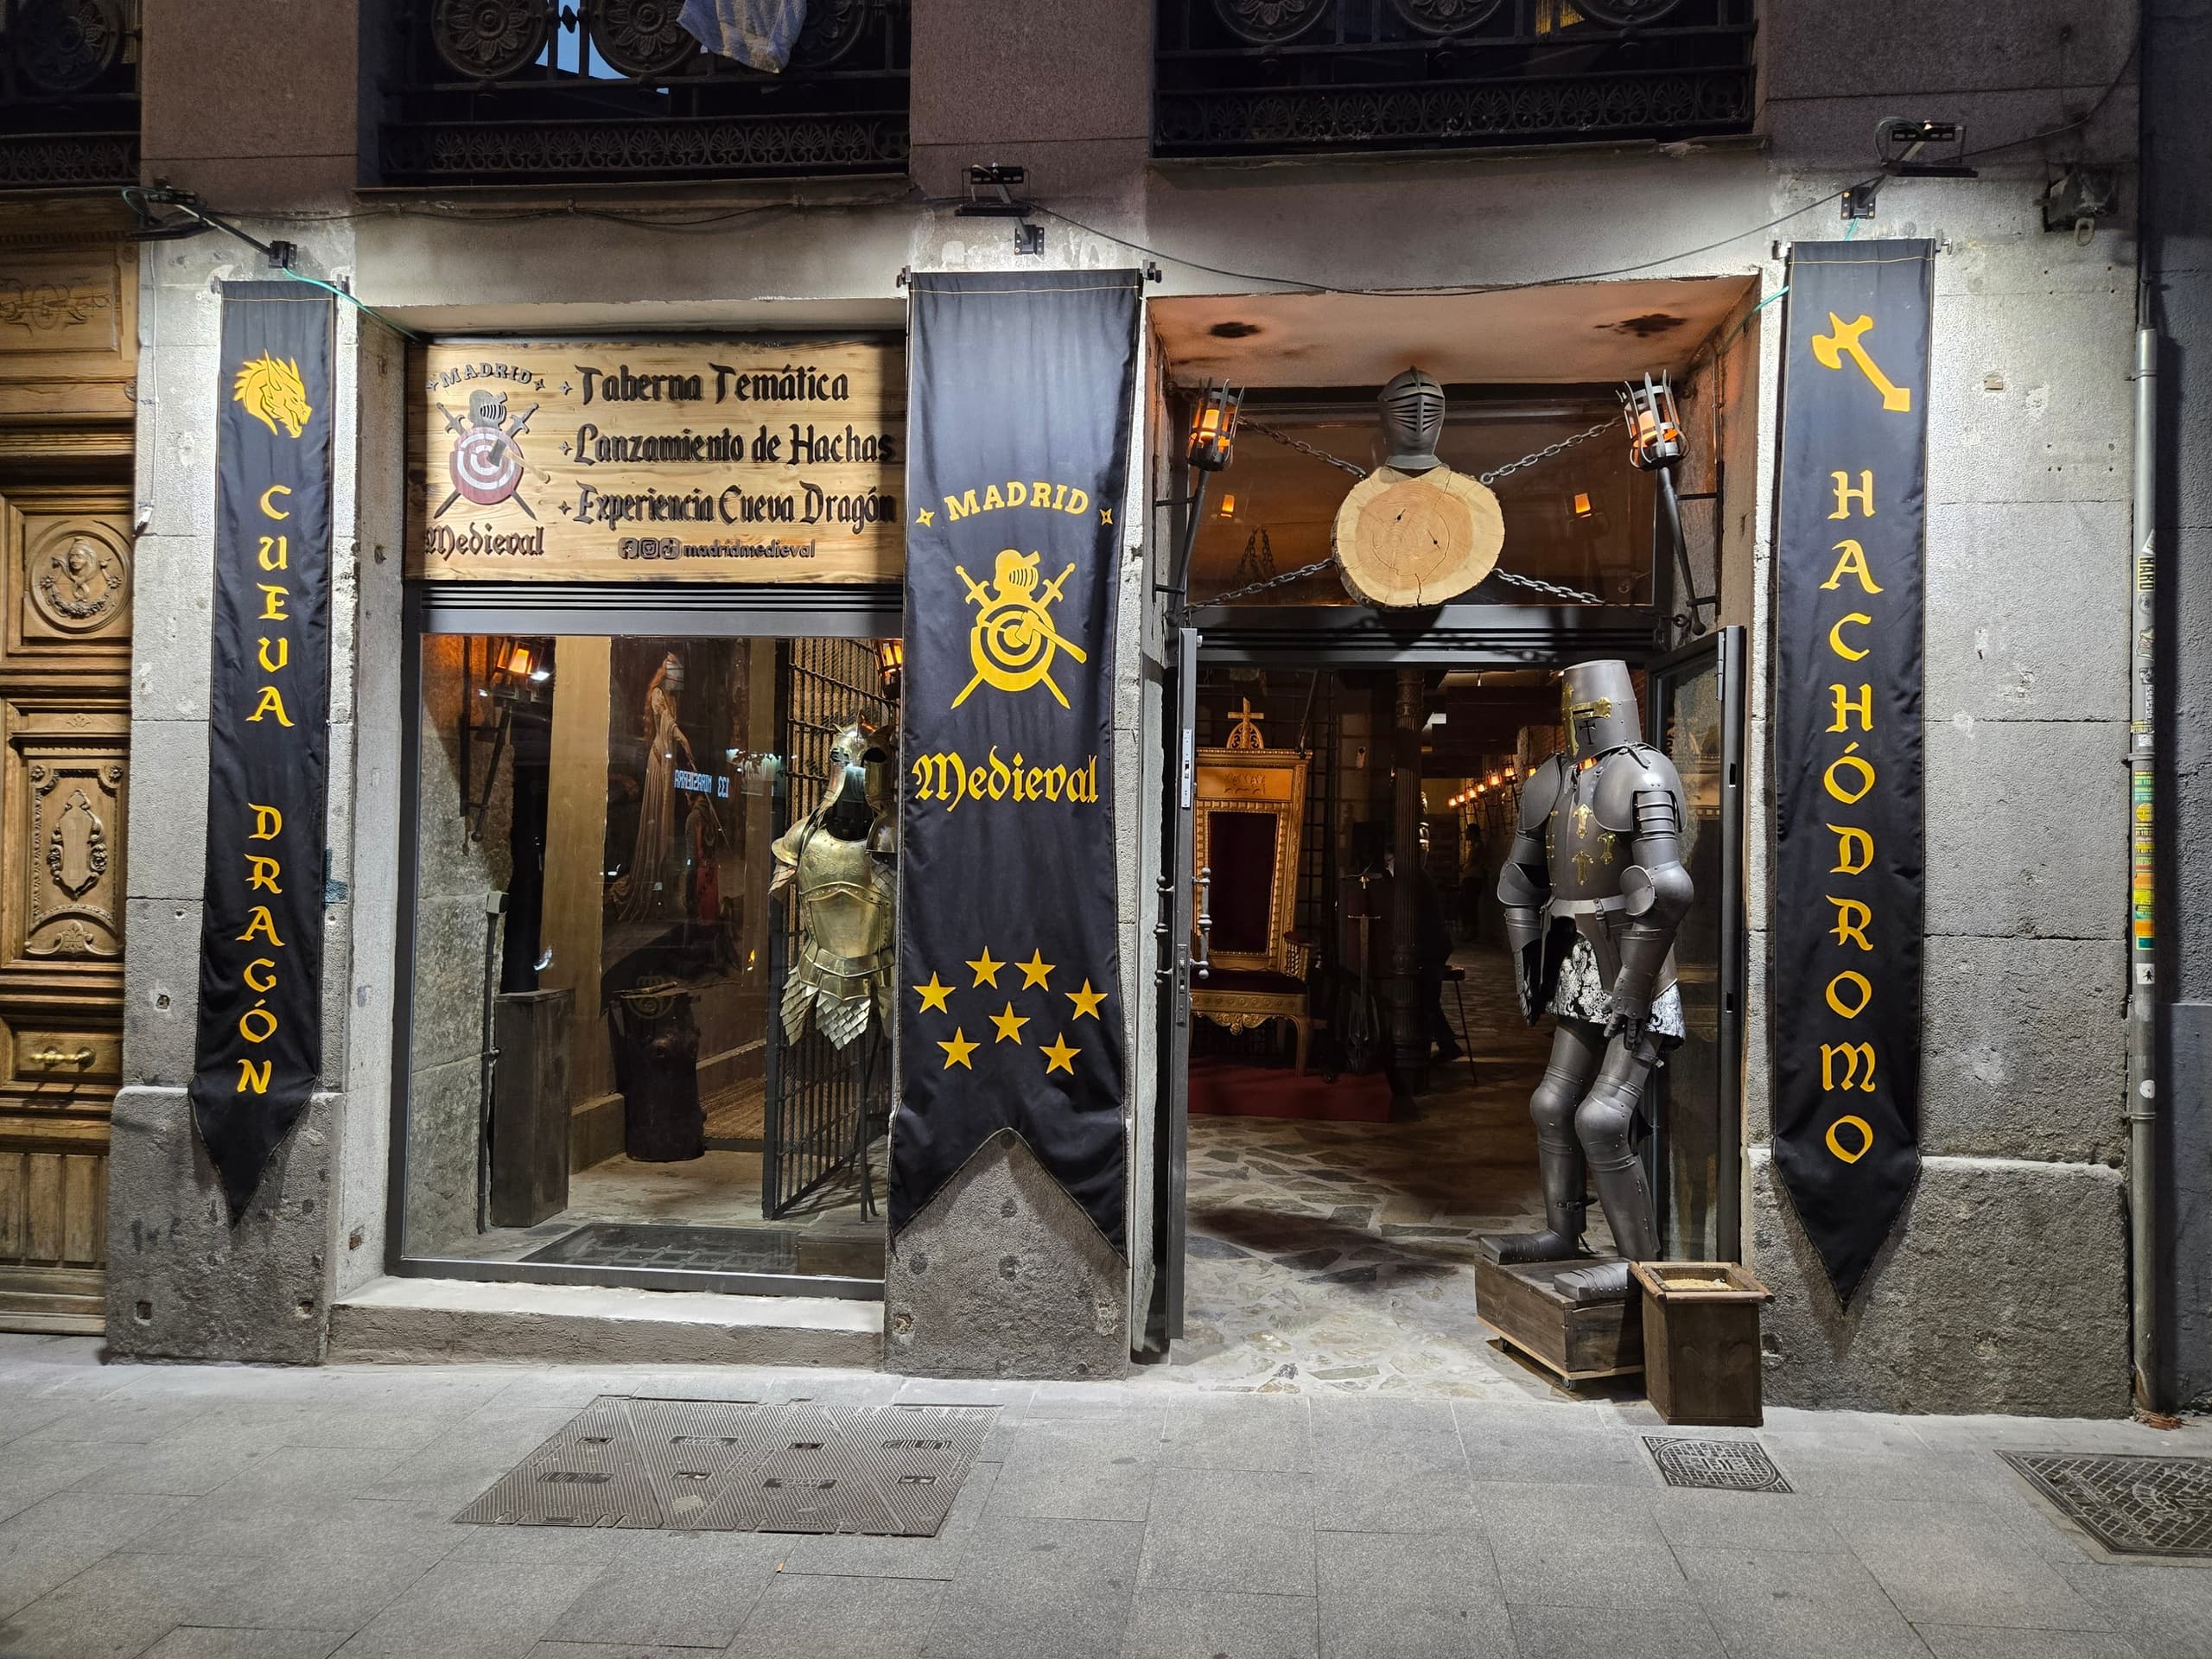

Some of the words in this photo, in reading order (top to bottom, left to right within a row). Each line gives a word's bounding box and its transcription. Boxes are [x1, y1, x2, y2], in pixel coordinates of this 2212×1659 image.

[439, 362, 533, 388] MADRID
[575, 364, 702, 405] Taberna
[709, 362, 849, 404] Temática
[574, 423, 744, 466] Lanzamiento
[752, 423, 782, 462] de
[785, 423, 894, 466] Hachas
[572, 480, 715, 531] Experiencia
[718, 484, 796, 525] Cueva
[798, 480, 897, 535] Dragón
[944, 481, 1090, 522] MADRID
[424, 521, 545, 562] Medieval
[683, 539, 816, 559] madridmedieval
[2139, 556, 2155, 591] HARD
[245, 484, 295, 728] CUEVA
[911, 745, 1099, 812] Medieval
[236, 803, 285, 1095] DRAGÓN
